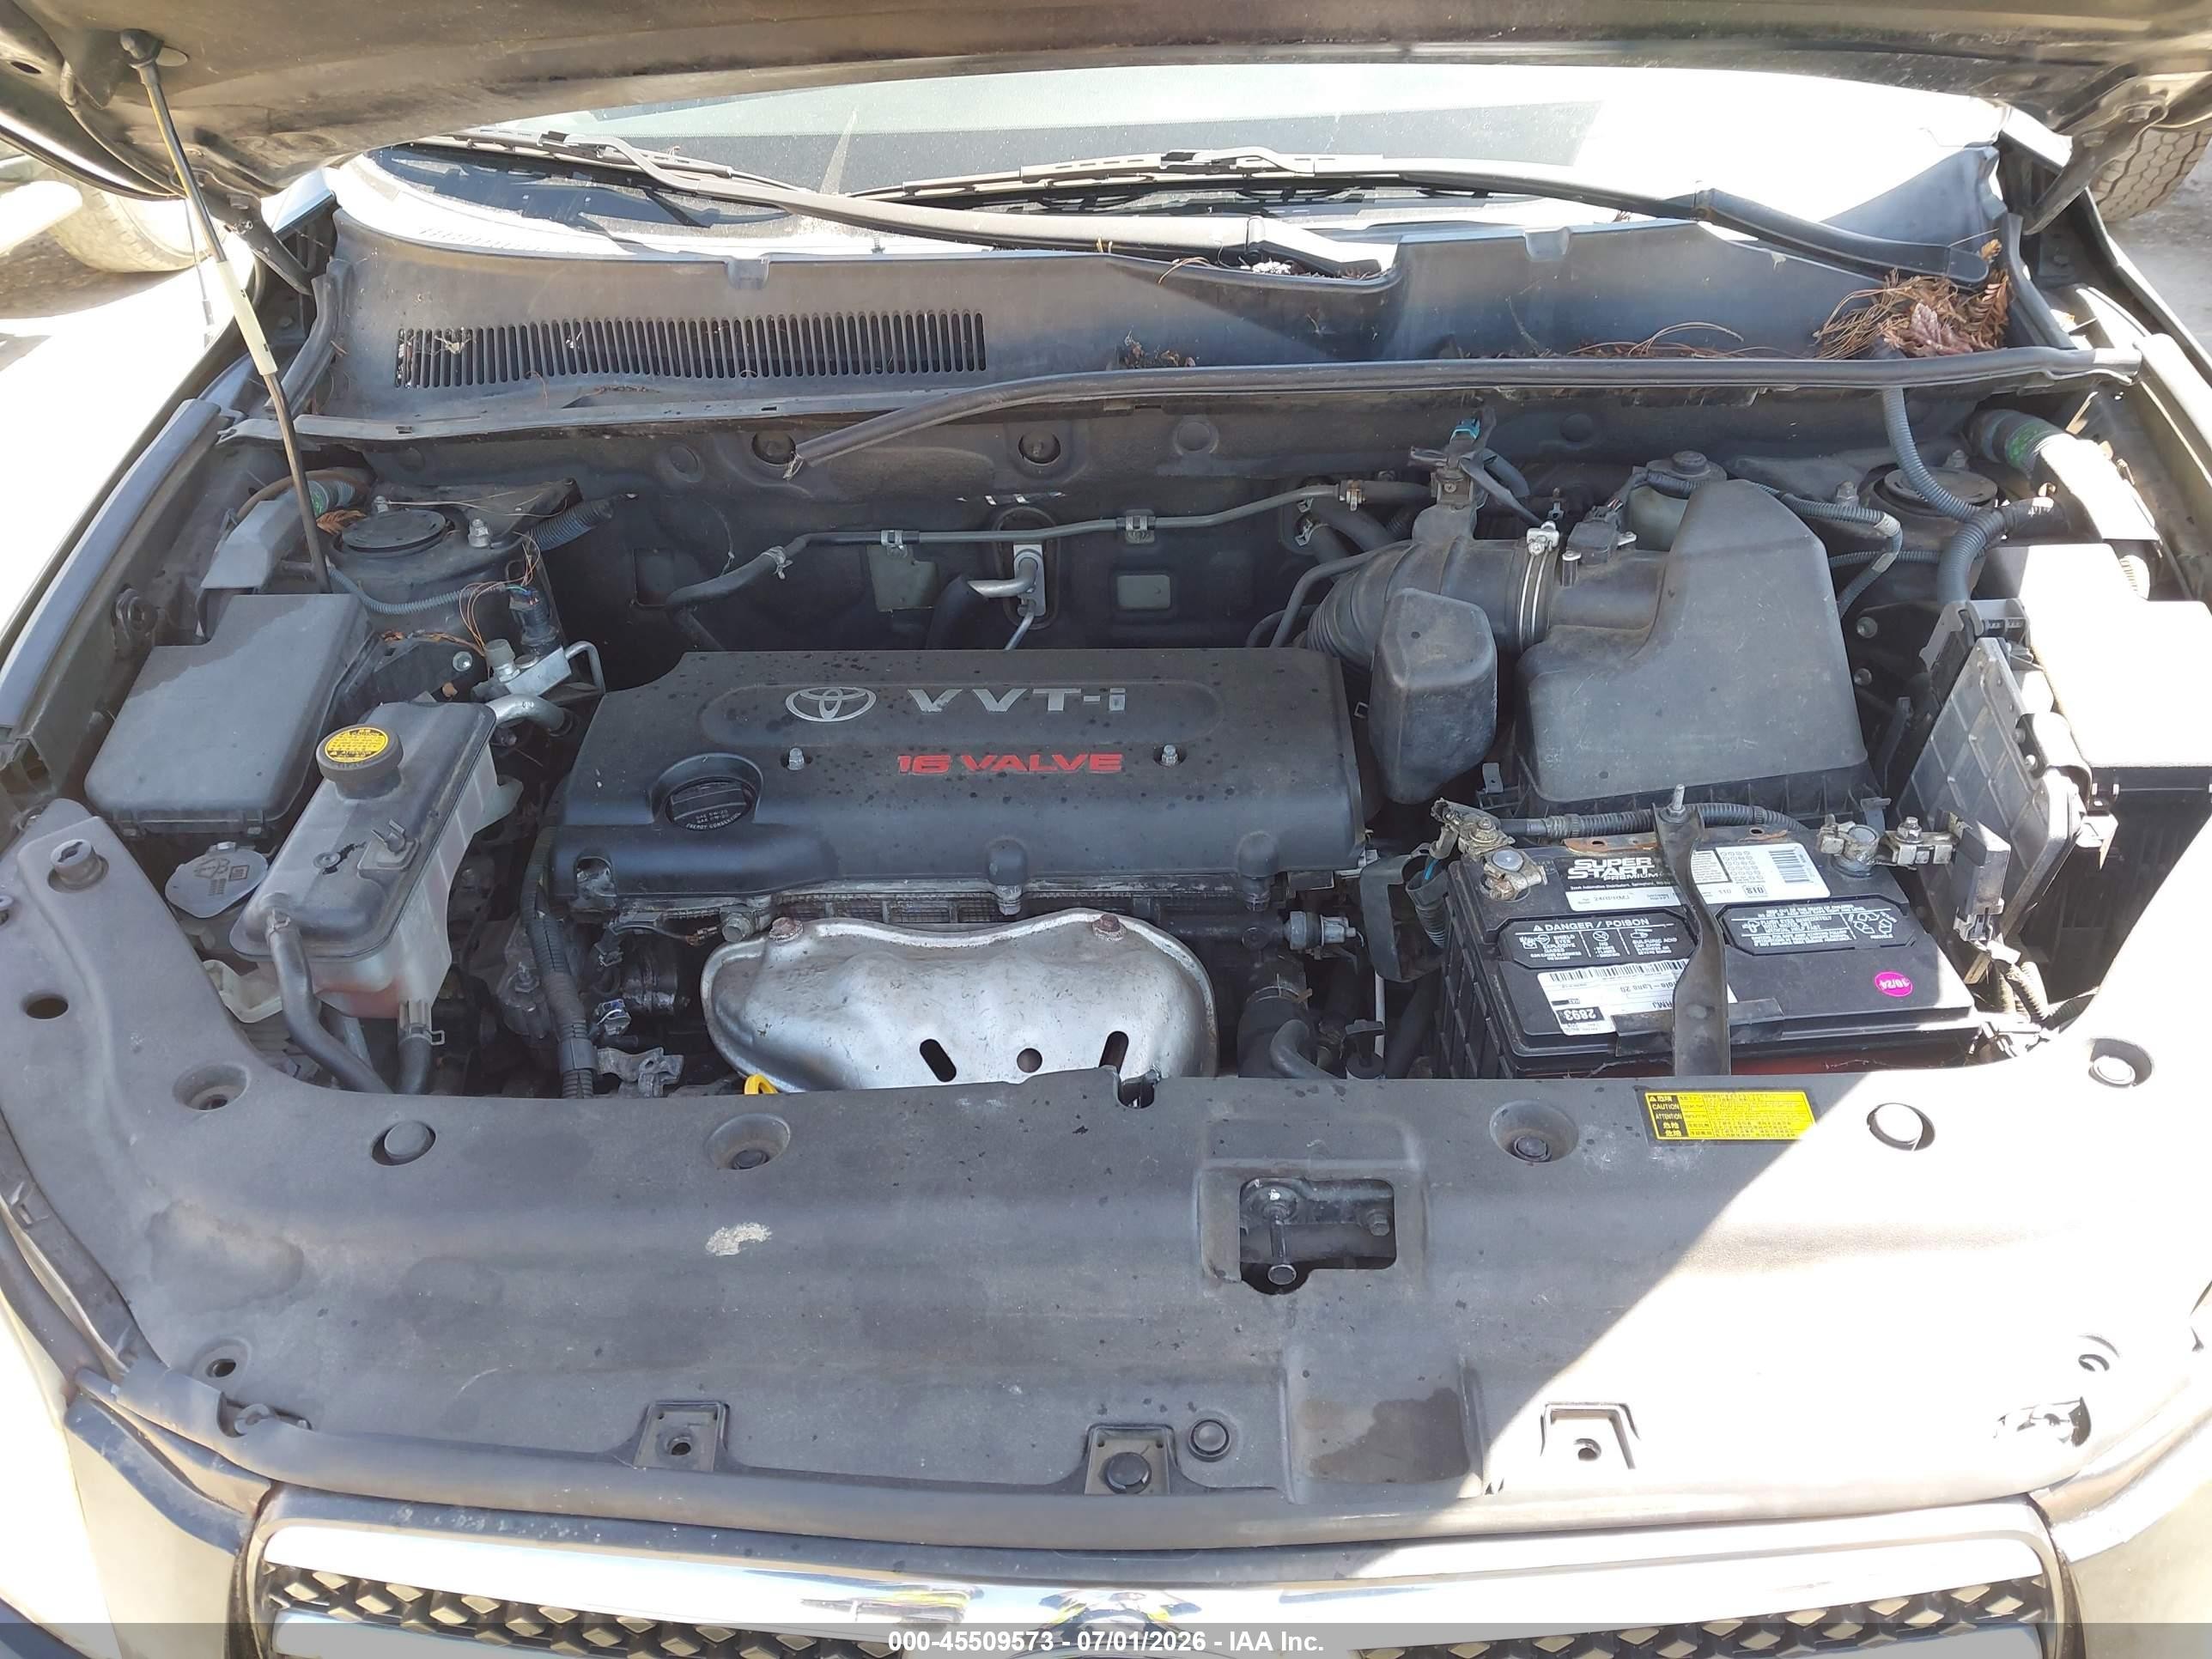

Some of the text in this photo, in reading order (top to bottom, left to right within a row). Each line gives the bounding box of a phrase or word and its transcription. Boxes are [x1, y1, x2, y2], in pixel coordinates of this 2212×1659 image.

[907, 688, 1126, 713] VVT-i
[897, 753, 1123, 774] 16 VALVE
[1574, 857, 1652, 868] SUPER
[1567, 865, 1655, 879] START
[1603, 872, 1659, 881] PREMIUM
[1545, 921, 1594, 932] DANGER
[1606, 918, 1650, 928] POISON
